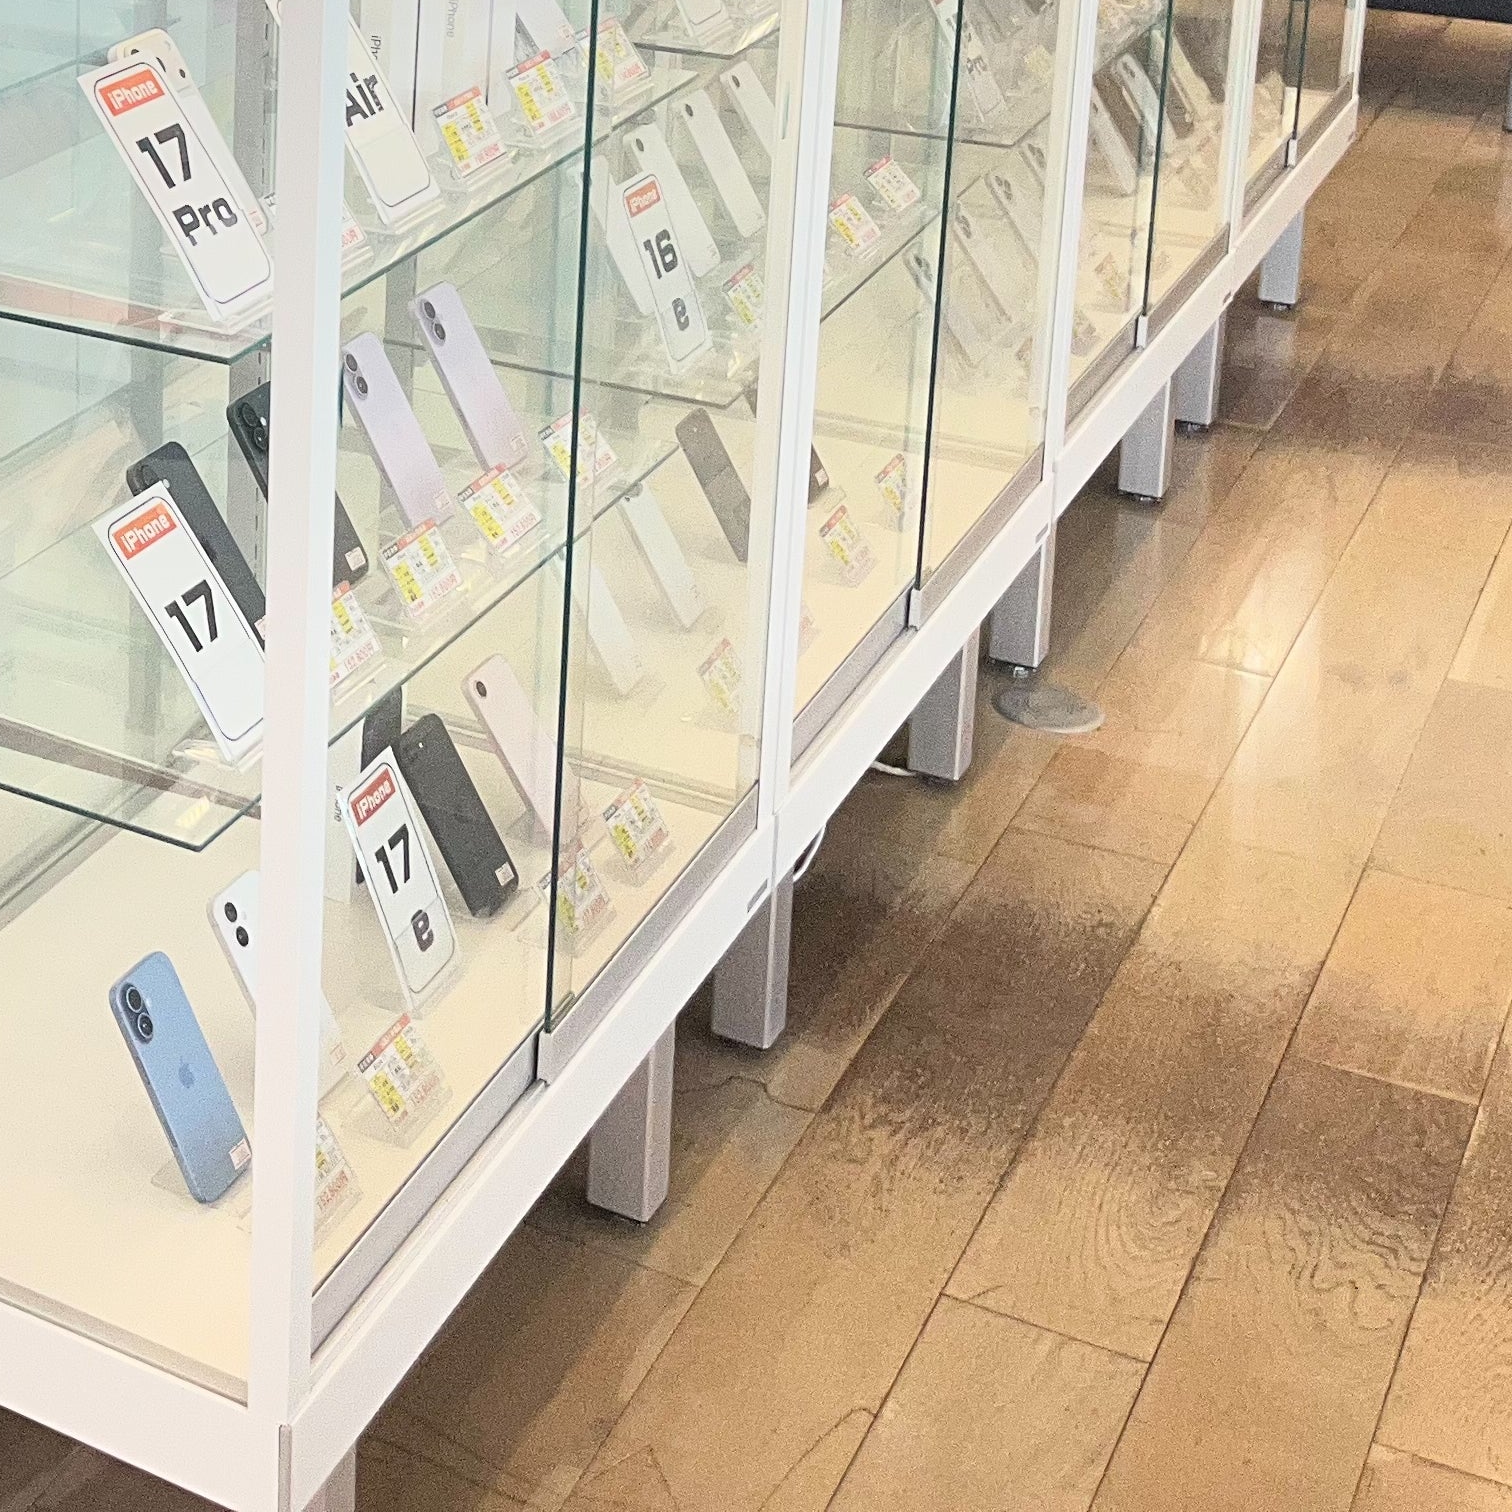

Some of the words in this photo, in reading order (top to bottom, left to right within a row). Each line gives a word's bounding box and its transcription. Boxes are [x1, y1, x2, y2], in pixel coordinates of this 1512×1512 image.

[370, 35, 382, 60] iPh
[109, 78, 159, 111] iPhone
[136, 123, 192, 189] 17
[172, 197, 239, 246] Pro
[643, 229, 678, 280] 16
[672, 297, 690, 331] e
[122, 510, 171, 551] iPhone
[164, 579, 221, 653] 17
[356, 778, 392, 821] iPhone
[375, 823, 411, 894] 17
[411, 909, 435, 952] e
